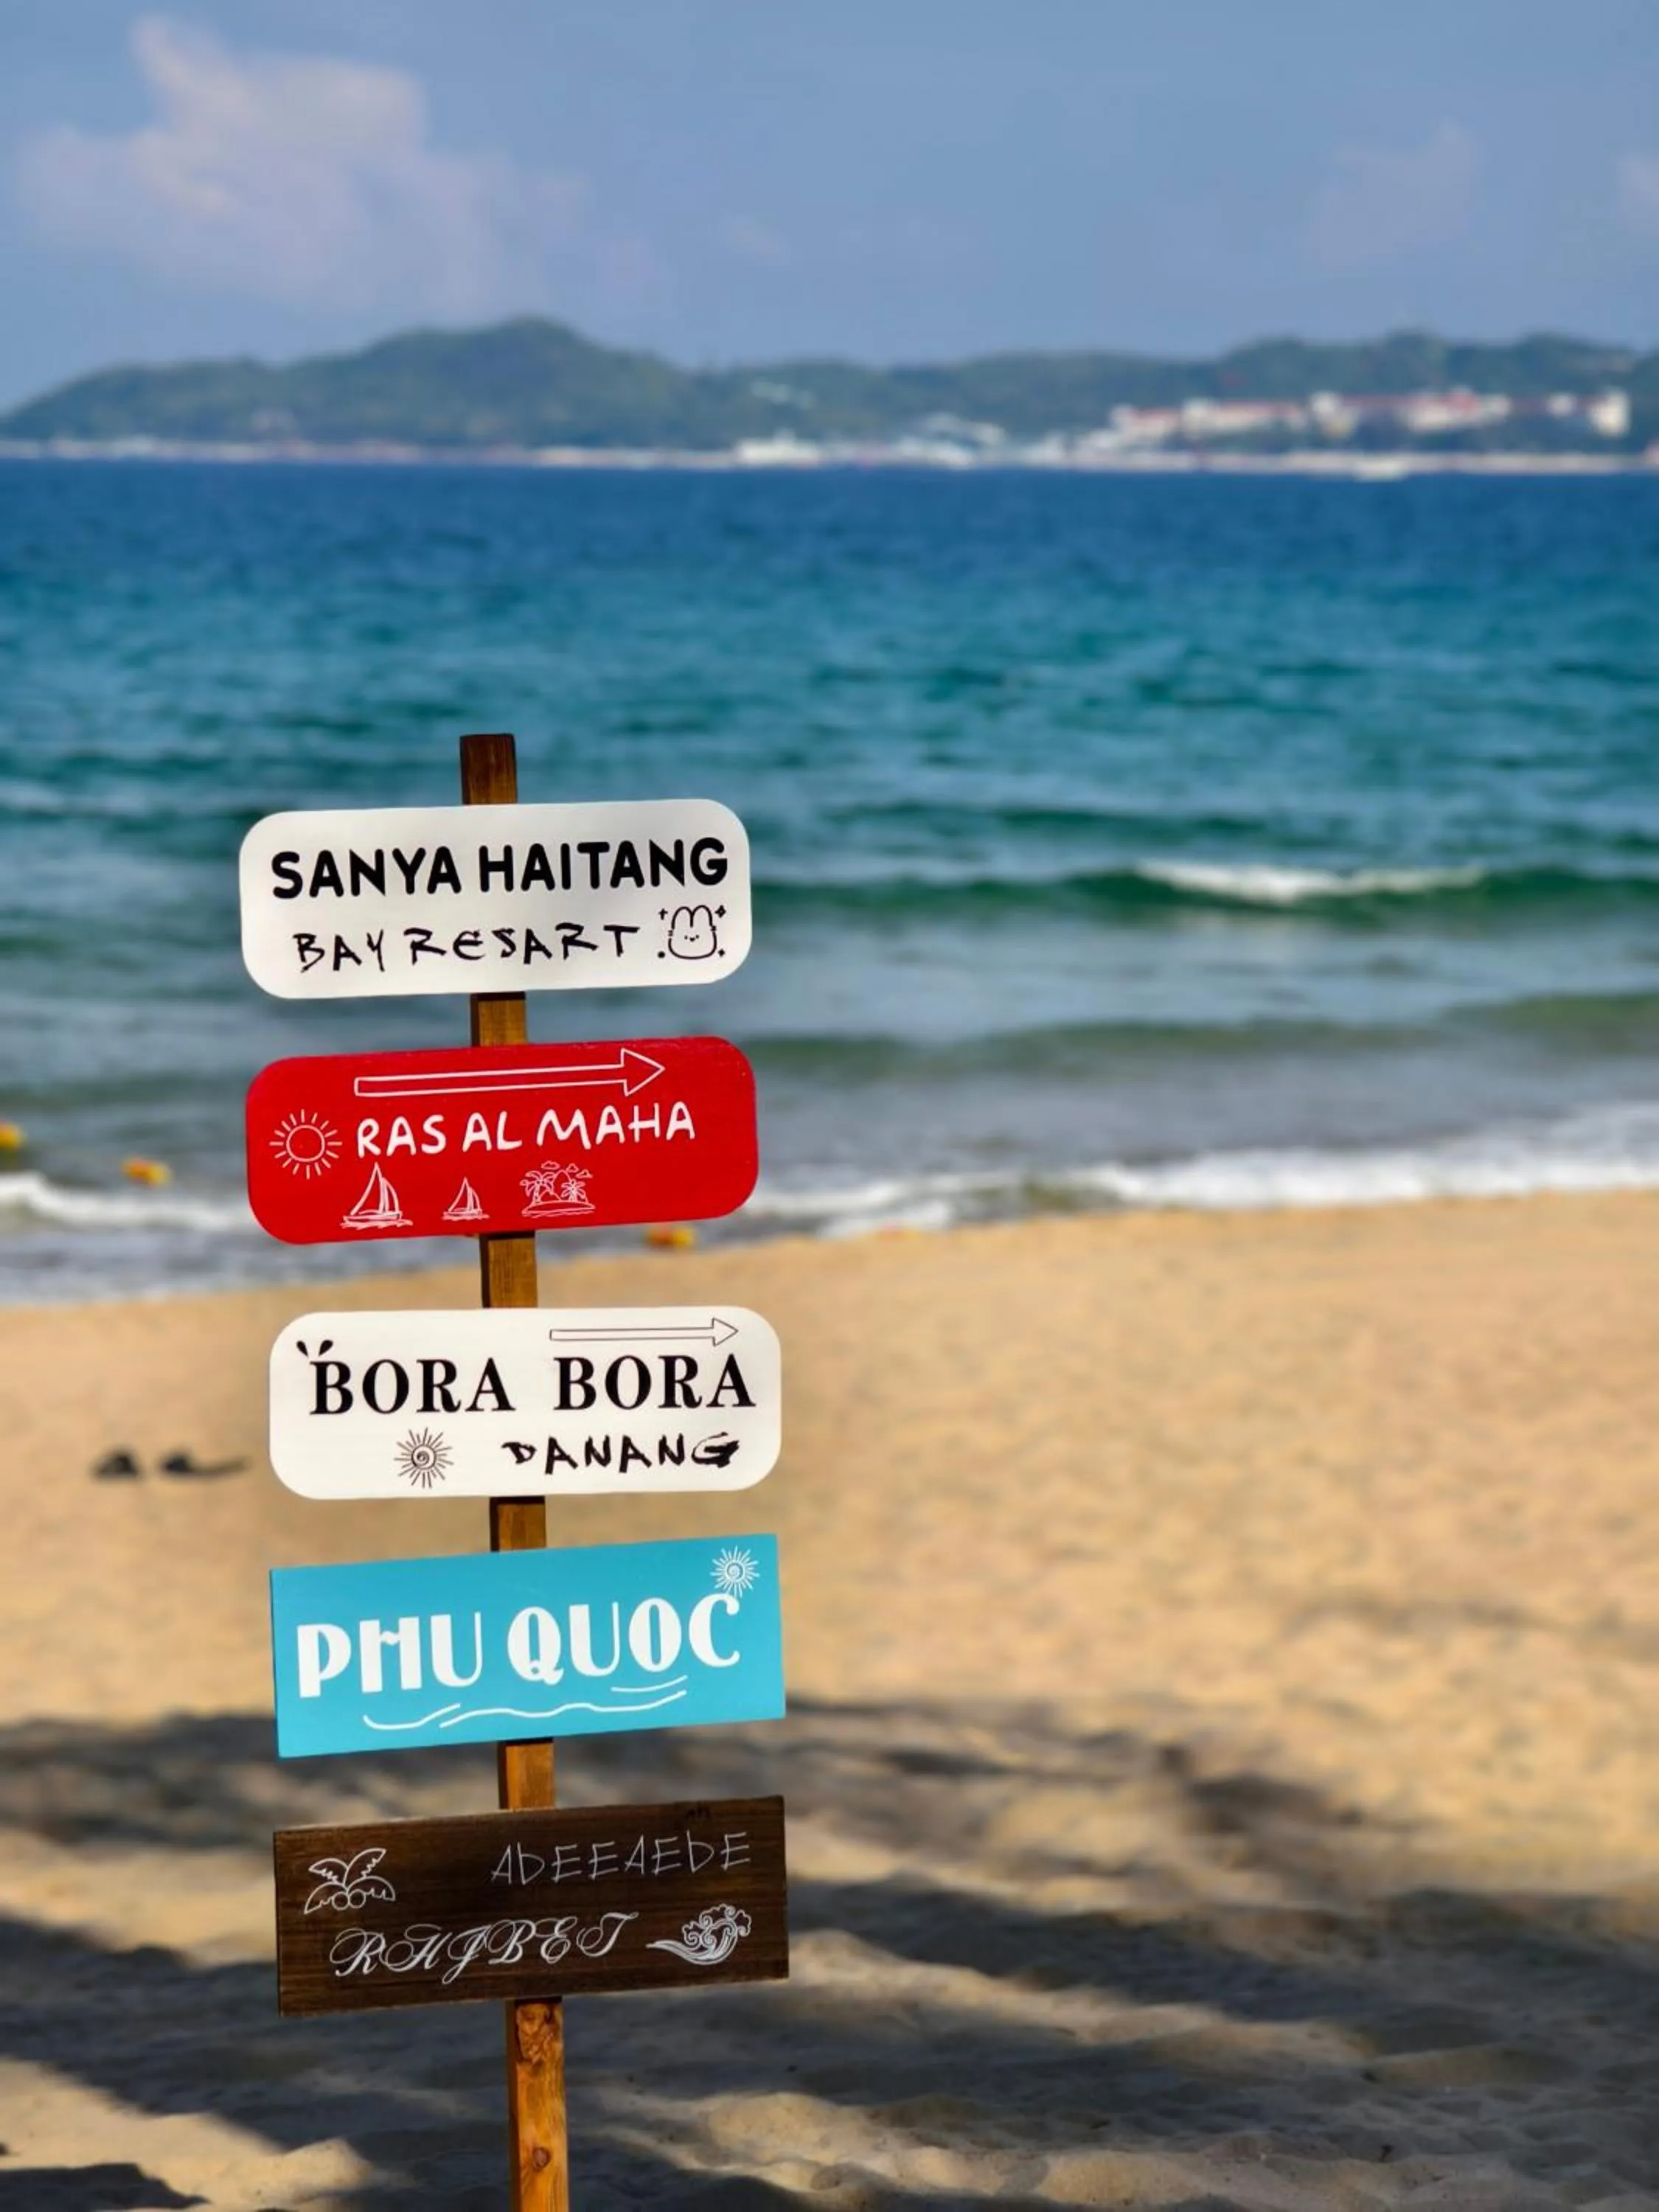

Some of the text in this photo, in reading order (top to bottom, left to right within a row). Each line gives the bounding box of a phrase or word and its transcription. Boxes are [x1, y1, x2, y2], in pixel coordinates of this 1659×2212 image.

[271, 837, 728, 900] SANYA HAITANG
[293, 929, 385, 973] BAY
[358, 1101, 695, 1158] RAS AL MAHA
[310, 1352, 757, 1415] BORA BORA
[501, 1432, 740, 1475] DANANG
[297, 1593, 740, 1698] PHU QUOC
